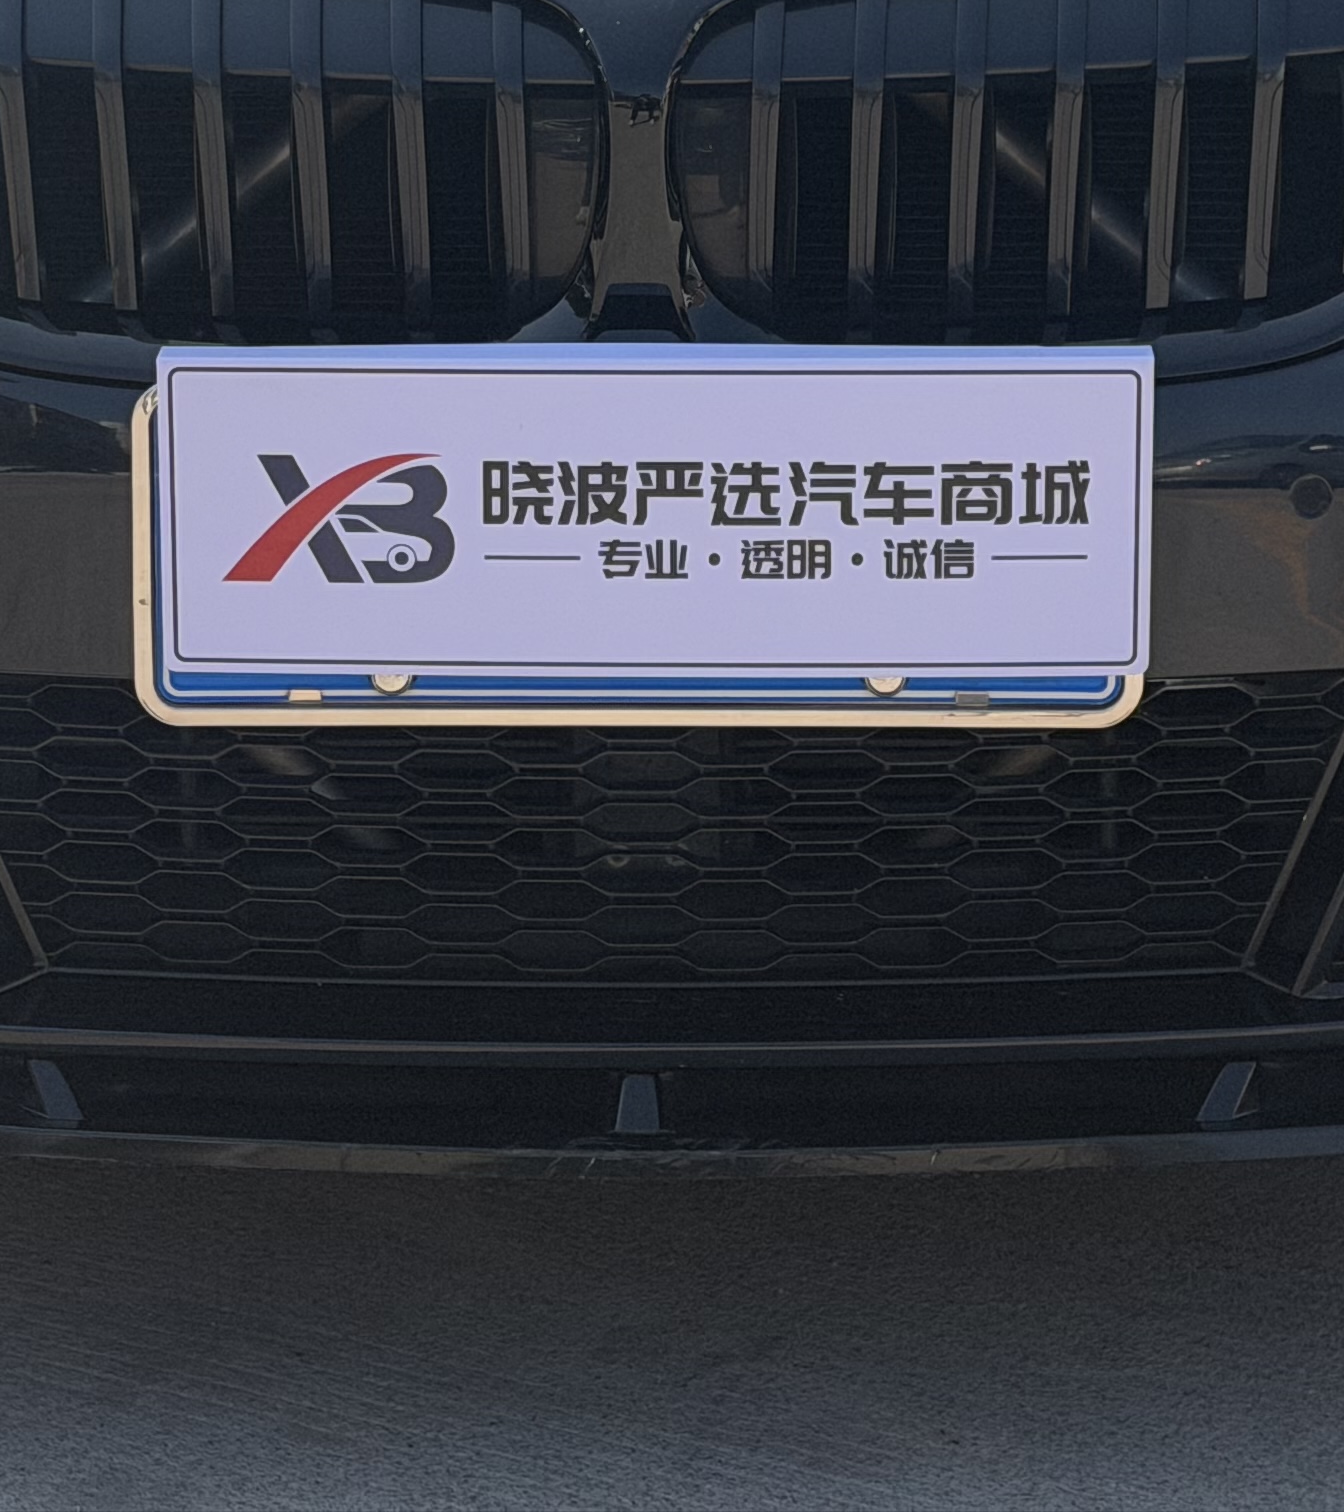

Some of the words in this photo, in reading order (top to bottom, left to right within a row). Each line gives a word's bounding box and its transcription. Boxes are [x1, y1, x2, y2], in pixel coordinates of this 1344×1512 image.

[483, 460, 1090, 526] 晓波严选汽车商城
